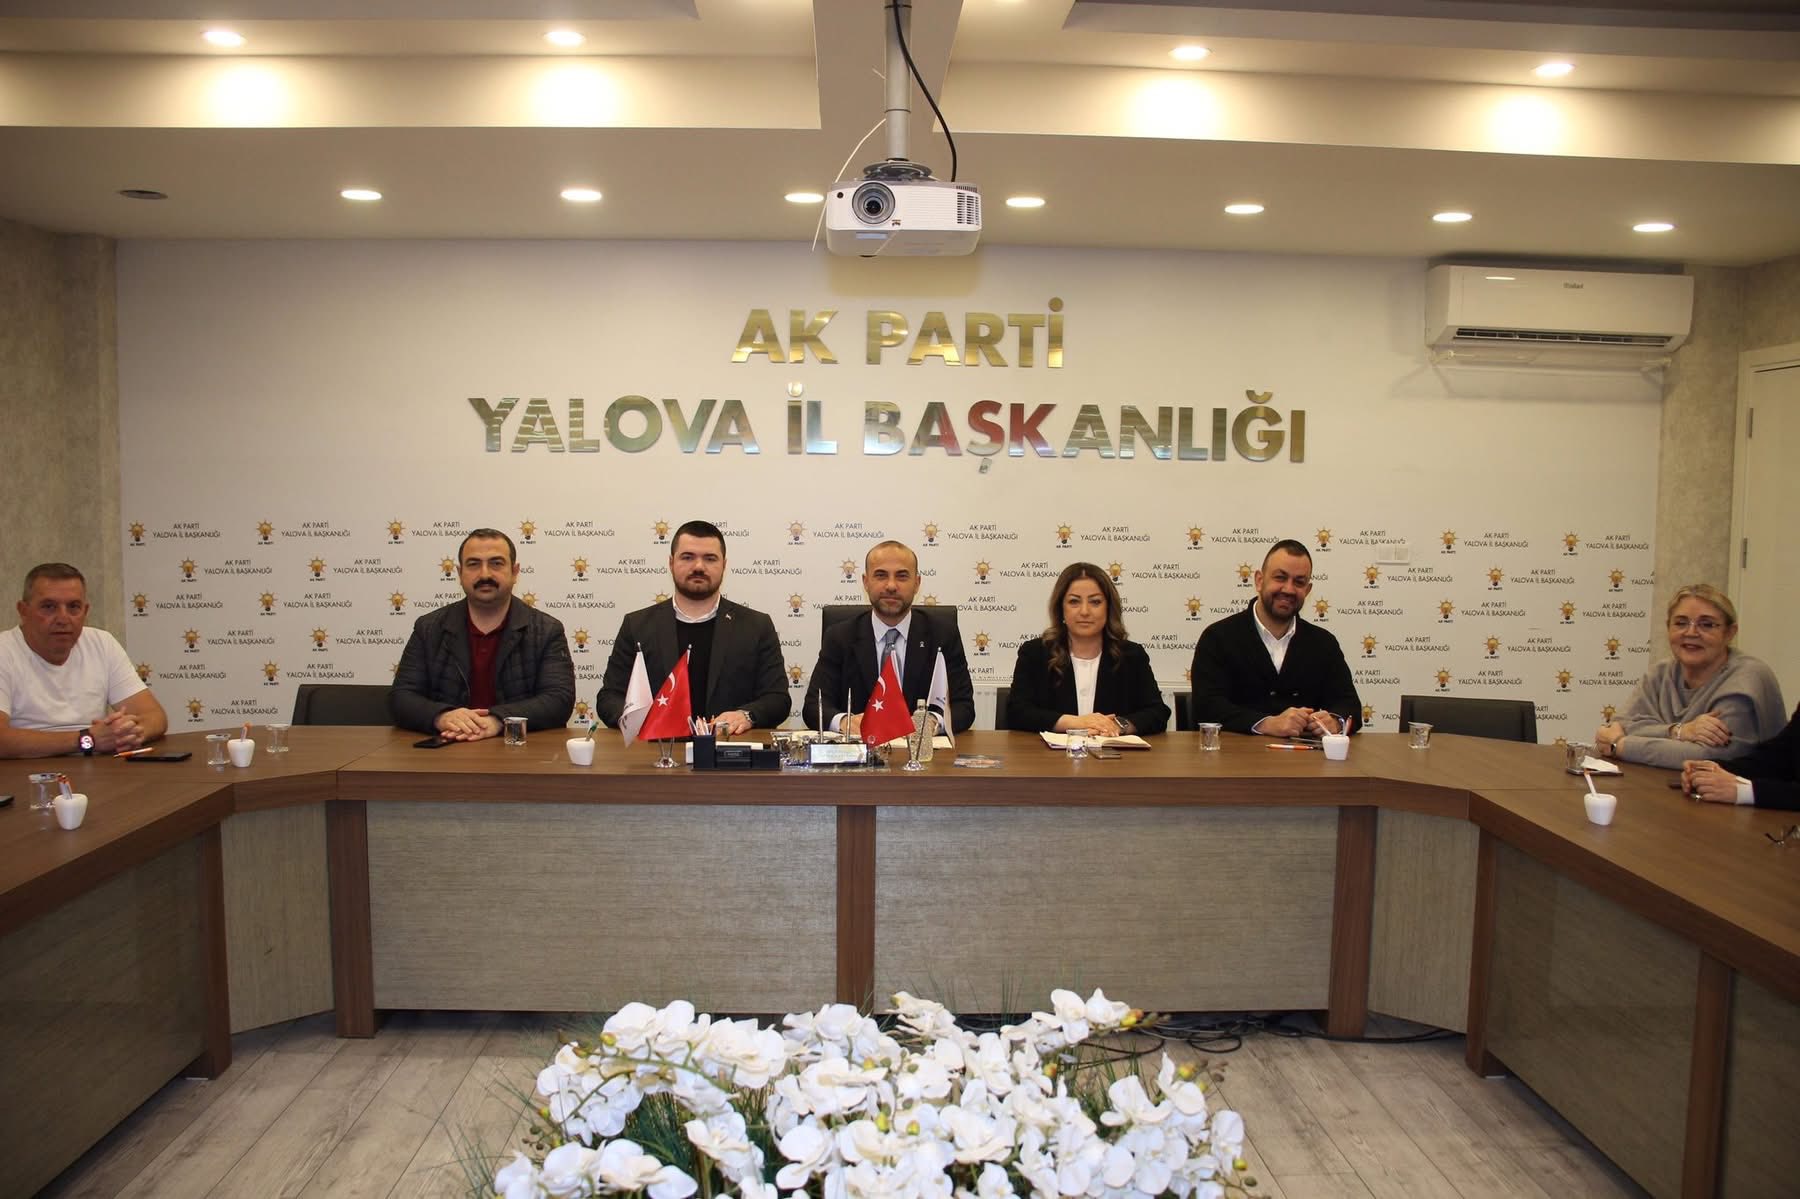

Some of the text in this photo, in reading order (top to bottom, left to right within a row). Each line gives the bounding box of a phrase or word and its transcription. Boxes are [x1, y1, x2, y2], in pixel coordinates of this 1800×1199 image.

[731, 297, 1064, 369] AK PARTİ
[467, 382, 1306, 474] YALOVA İL BAŞKANLIĞI
